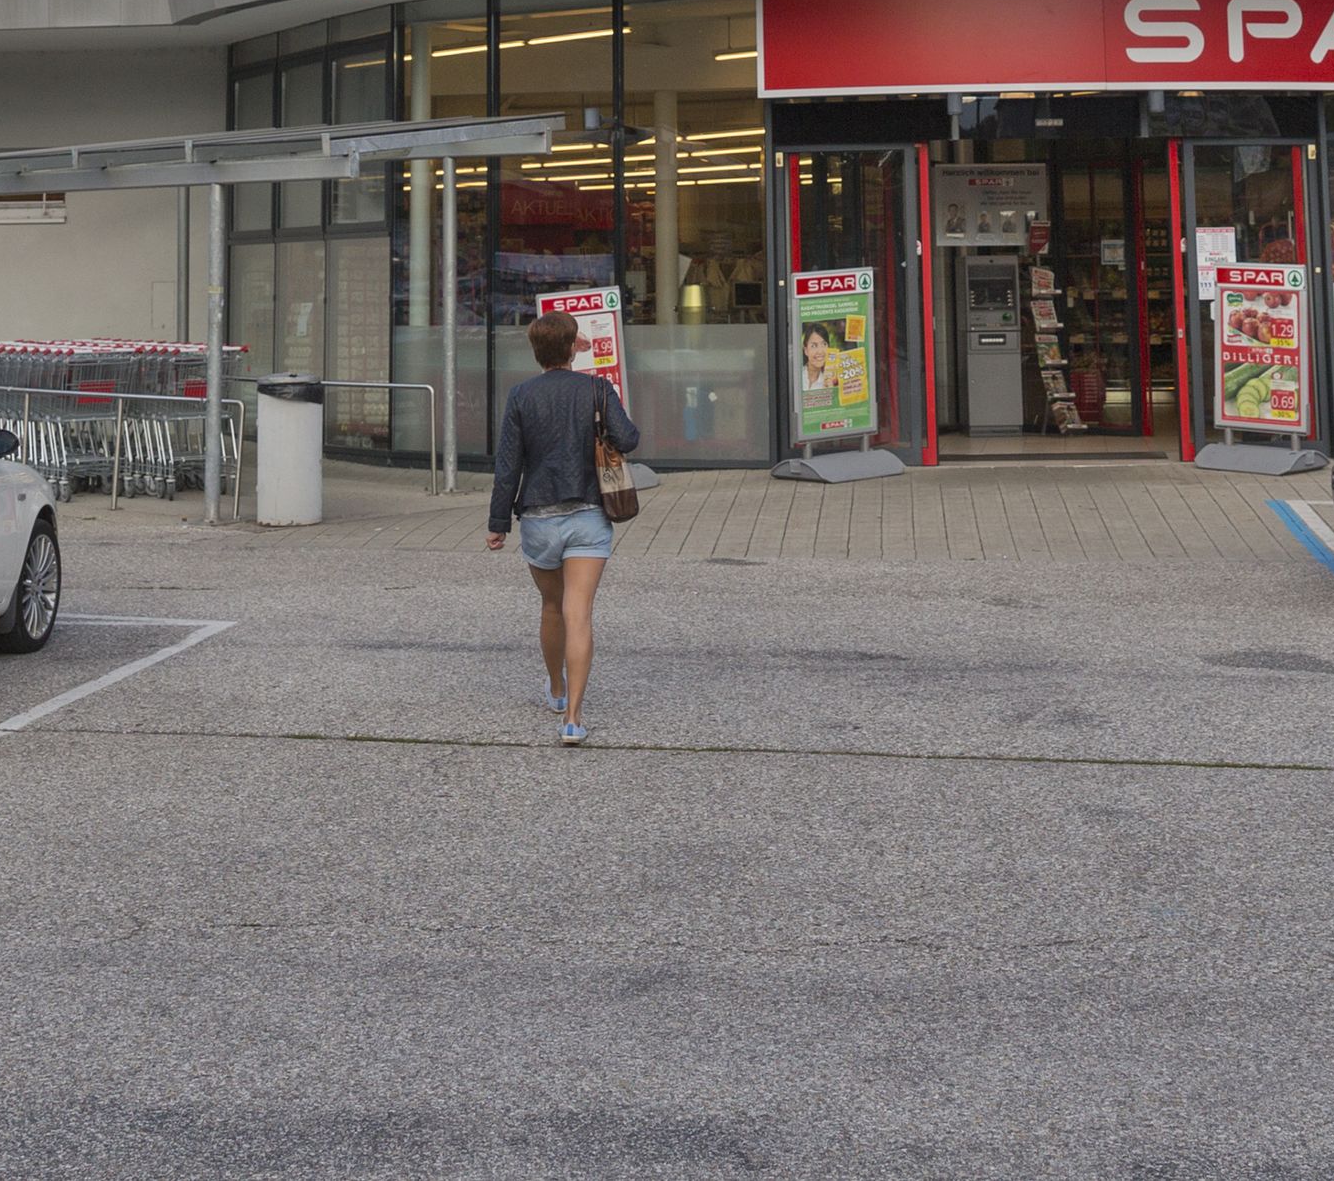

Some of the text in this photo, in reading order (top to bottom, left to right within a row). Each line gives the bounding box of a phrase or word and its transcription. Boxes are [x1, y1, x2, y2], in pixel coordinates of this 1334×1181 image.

[808, 277, 855, 291] SPAR
[1229, 270, 1284, 284] SPAR
[553, 296, 602, 311] SPAR
[1271, 324, 1294, 337] 1.29
[593, 340, 612, 354] 4.99
[1223, 351, 1298, 365] BILLIGER!
[1271, 395, 1295, 409] 0.69
